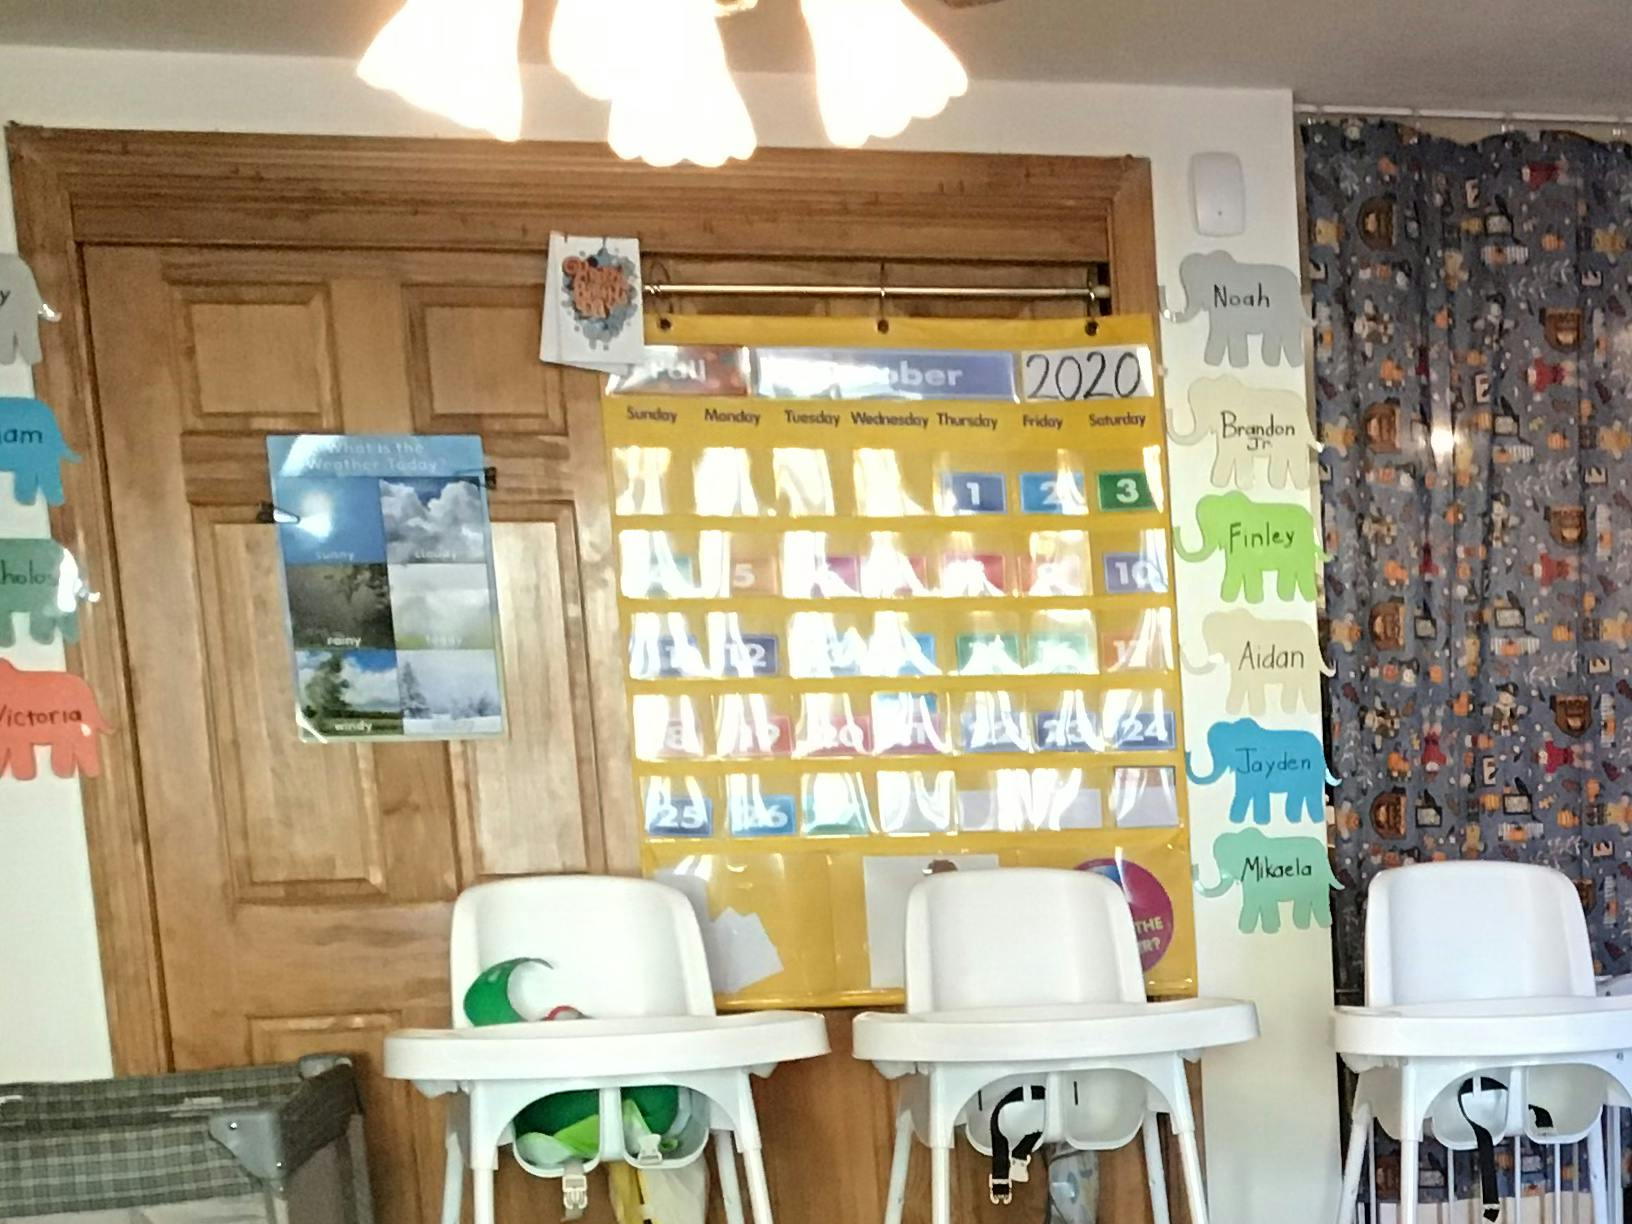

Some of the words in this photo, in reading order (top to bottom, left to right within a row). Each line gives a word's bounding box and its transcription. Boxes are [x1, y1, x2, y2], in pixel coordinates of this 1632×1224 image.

[1212, 283, 1271, 309] Noah
[1025, 351, 1141, 401] 2020
[626, 405, 678, 424] Sunday
[704, 407, 761, 427] Monday
[784, 409, 841, 428] Tuesday
[850, 410, 929, 429] Wednesday
[936, 411, 998, 430] Thursday
[1022, 413, 1063, 431] Friday
[1089, 411, 1147, 428] Saturday
[1221, 410, 1296, 438] Brandon
[326, 440, 373, 455] What
[396, 440, 425, 454] the
[305, 457, 380, 473] Weather
[965, 481, 982, 506] 1
[1115, 478, 1141, 504] 3
[1228, 521, 1296, 556] Finley
[733, 563, 756, 588] 5
[1238, 640, 1306, 672] Aidan
[333, 718, 373, 733] windy
[1235, 746, 1312, 780] Jayden
[656, 803, 705, 829] 25
[1240, 855, 1313, 882] Mikaela
[1134, 916, 1164, 934] THE
